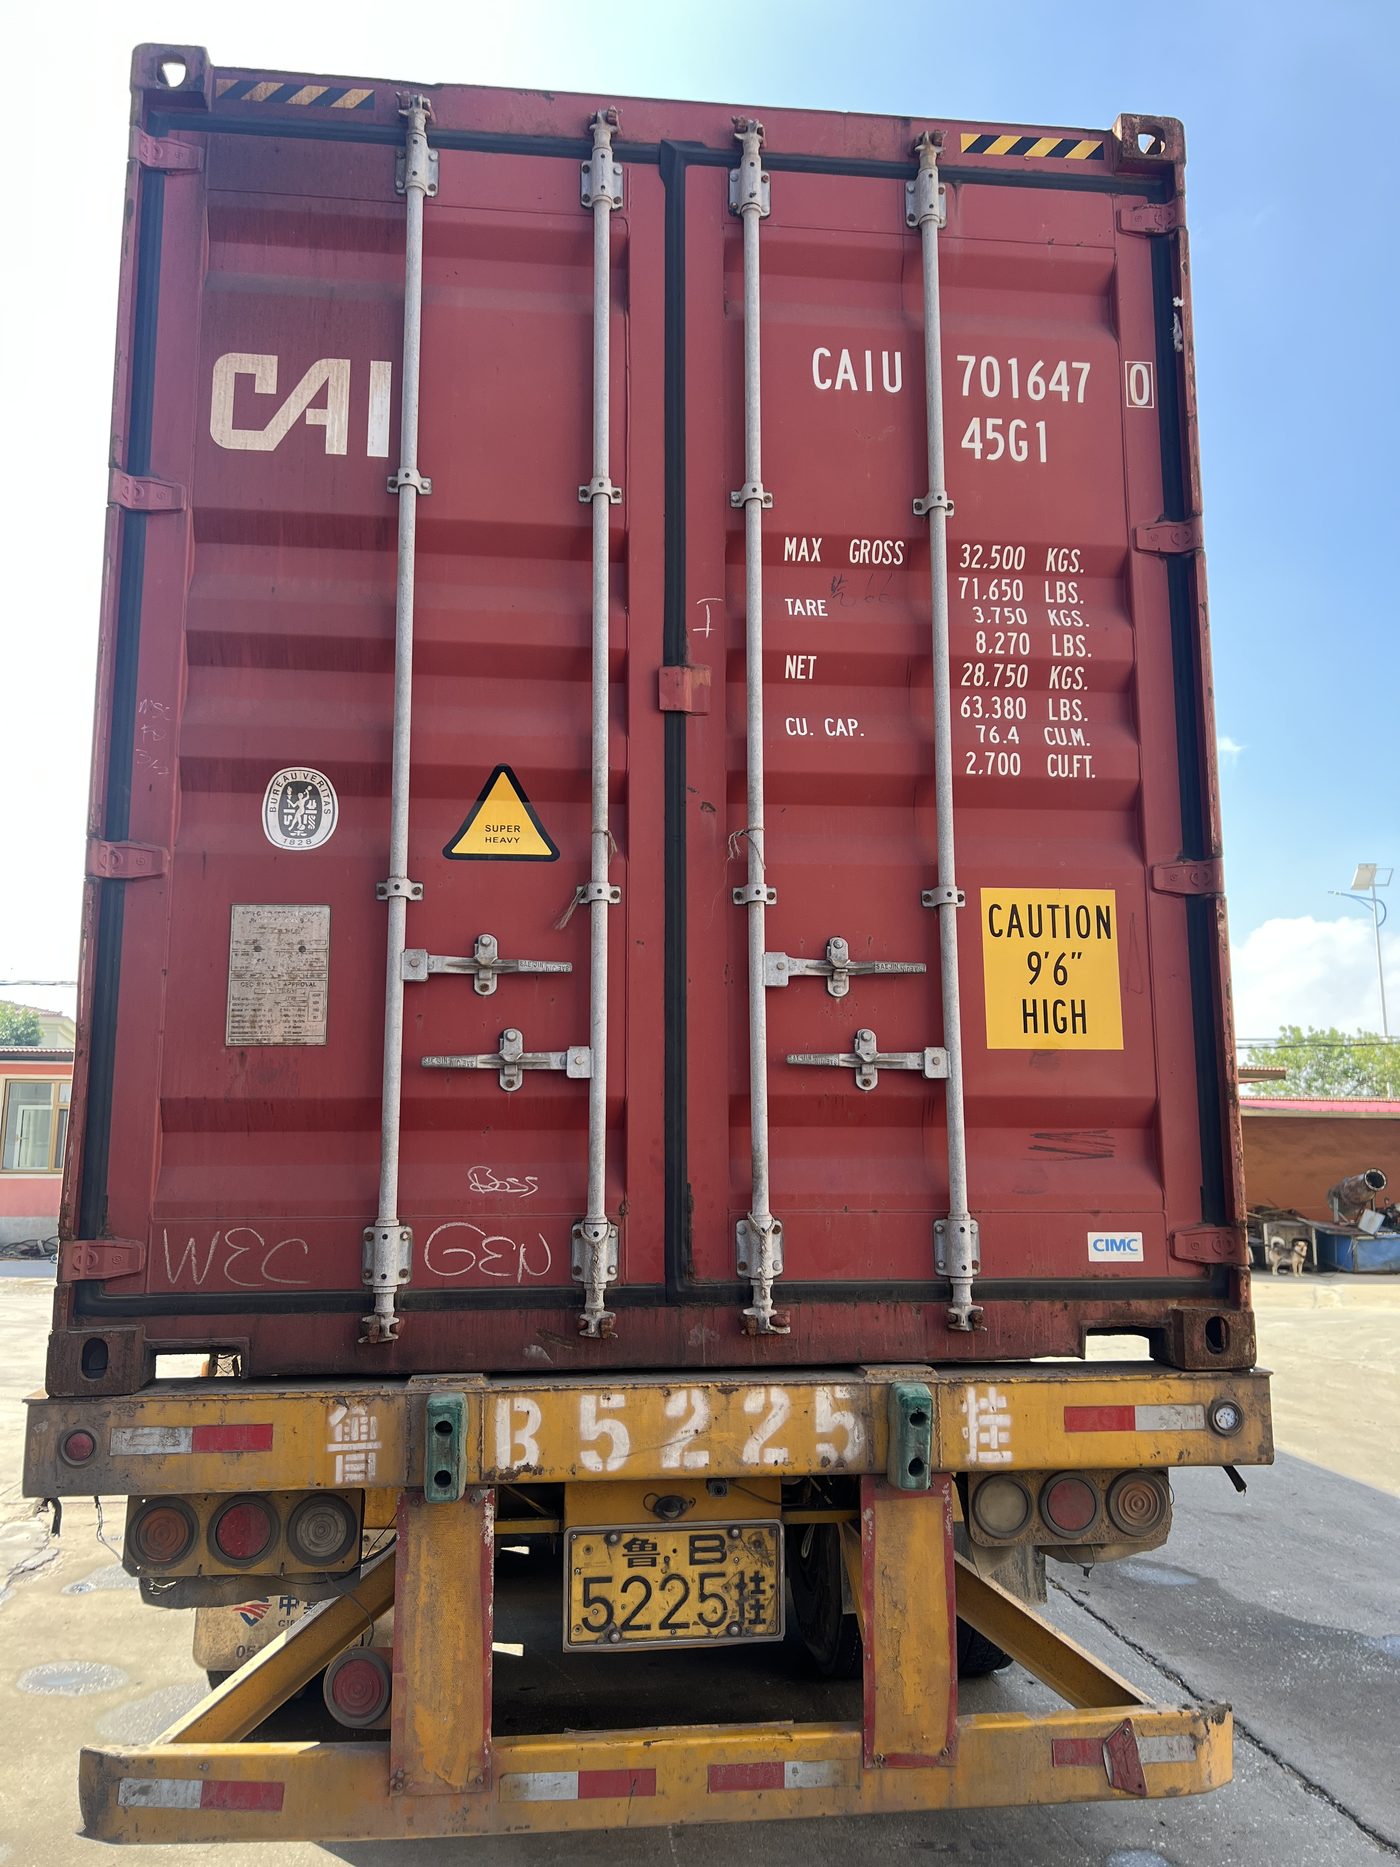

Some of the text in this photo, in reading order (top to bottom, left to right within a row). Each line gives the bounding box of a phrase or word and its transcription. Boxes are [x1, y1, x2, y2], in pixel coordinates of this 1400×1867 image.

[812, 347, 1150, 406] CAIU 701647 0
[210, 352, 392, 458] CAI
[961, 416, 1047, 463] 45G1
[783, 536, 823, 562] MAX
[849, 538, 905, 565] GROSS
[1045, 547, 1085, 574] KGS.
[1044, 580, 1084, 605] LBS.
[784, 598, 829, 617] TARE
[1047, 608, 1090, 628] KGS.
[1051, 633, 1092, 658] LBS.
[785, 654, 817, 680] NET
[1048, 665, 1088, 691] KGS.
[1048, 698, 1089, 722] LBS.
[785, 717, 814, 736] CU.
[824, 717, 865, 737] CAP.
[975, 724, 1020, 745] 76.4
[269, 772, 332, 815] BUREAU VERITAS
[283, 838, 312, 846] 1828
[484, 824, 521, 834] SUPER
[484, 836, 521, 844] HEAVY
[988, 903, 1112, 940] CAUTION
[1022, 999, 1087, 1034] HIGH
[1092, 1238, 1139, 1252] CIMC
[327, 1406, 382, 1484] 鲁
[961, 1385, 1013, 1465] 挂
